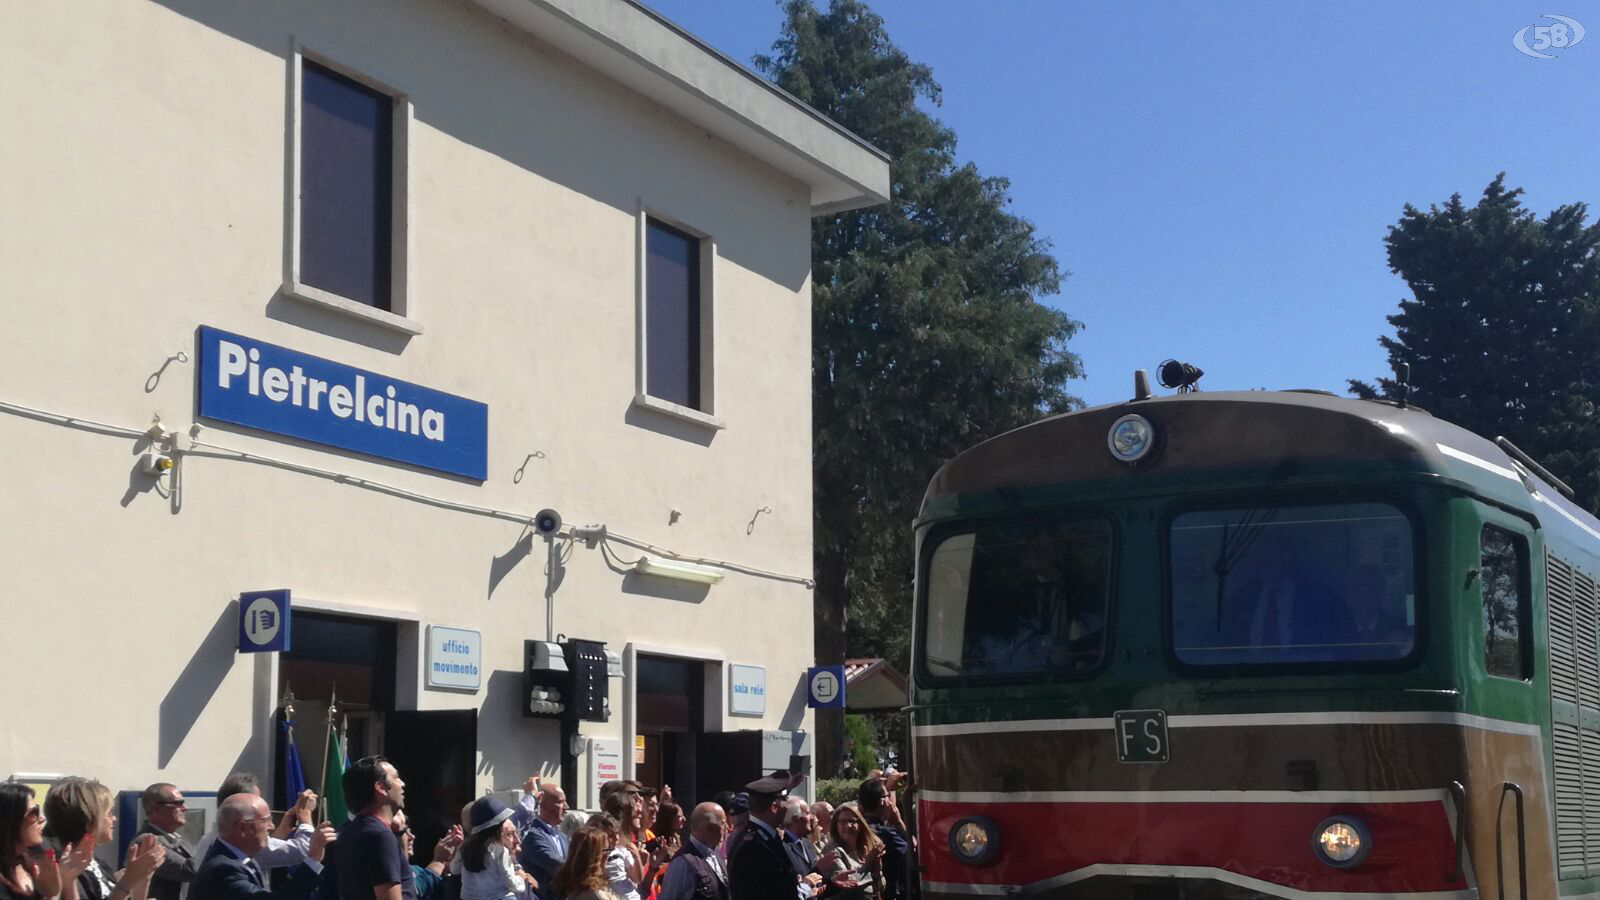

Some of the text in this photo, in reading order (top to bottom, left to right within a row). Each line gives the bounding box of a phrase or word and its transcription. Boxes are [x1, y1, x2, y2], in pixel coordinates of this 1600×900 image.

[218, 339, 445, 442] Pietrelcina
[442, 639, 470, 655] ufficio
[433, 661, 478, 675] movimento
[734, 682, 748, 694] sala
